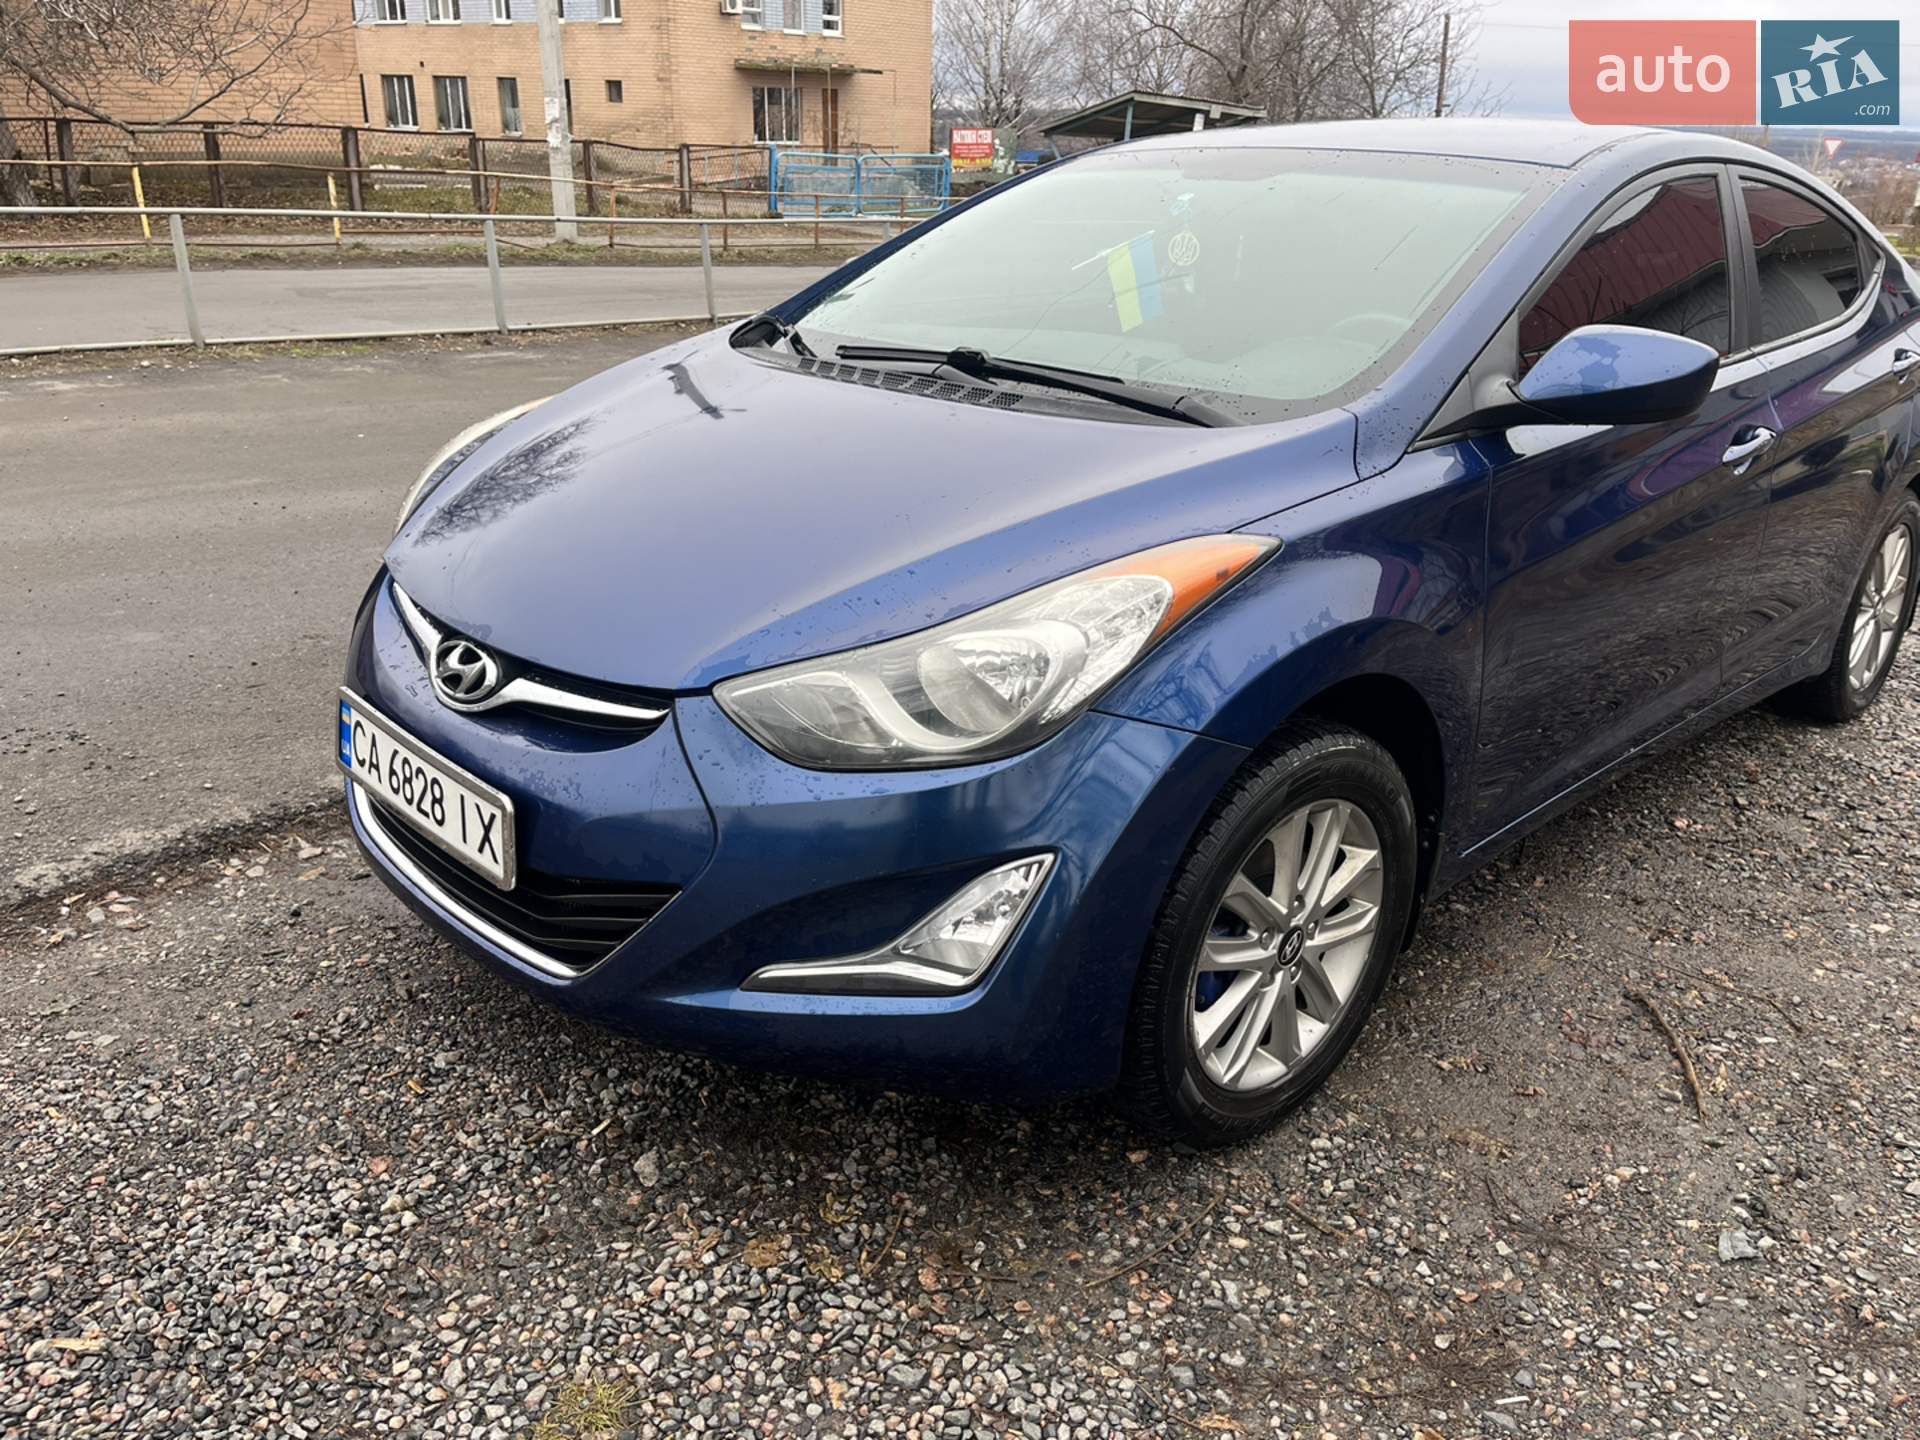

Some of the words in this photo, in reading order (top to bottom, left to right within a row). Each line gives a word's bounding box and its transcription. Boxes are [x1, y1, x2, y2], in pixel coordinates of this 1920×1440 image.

[353, 719, 382, 785] CA
[388, 749, 446, 827] 6828
[460, 793, 499, 865] IX
